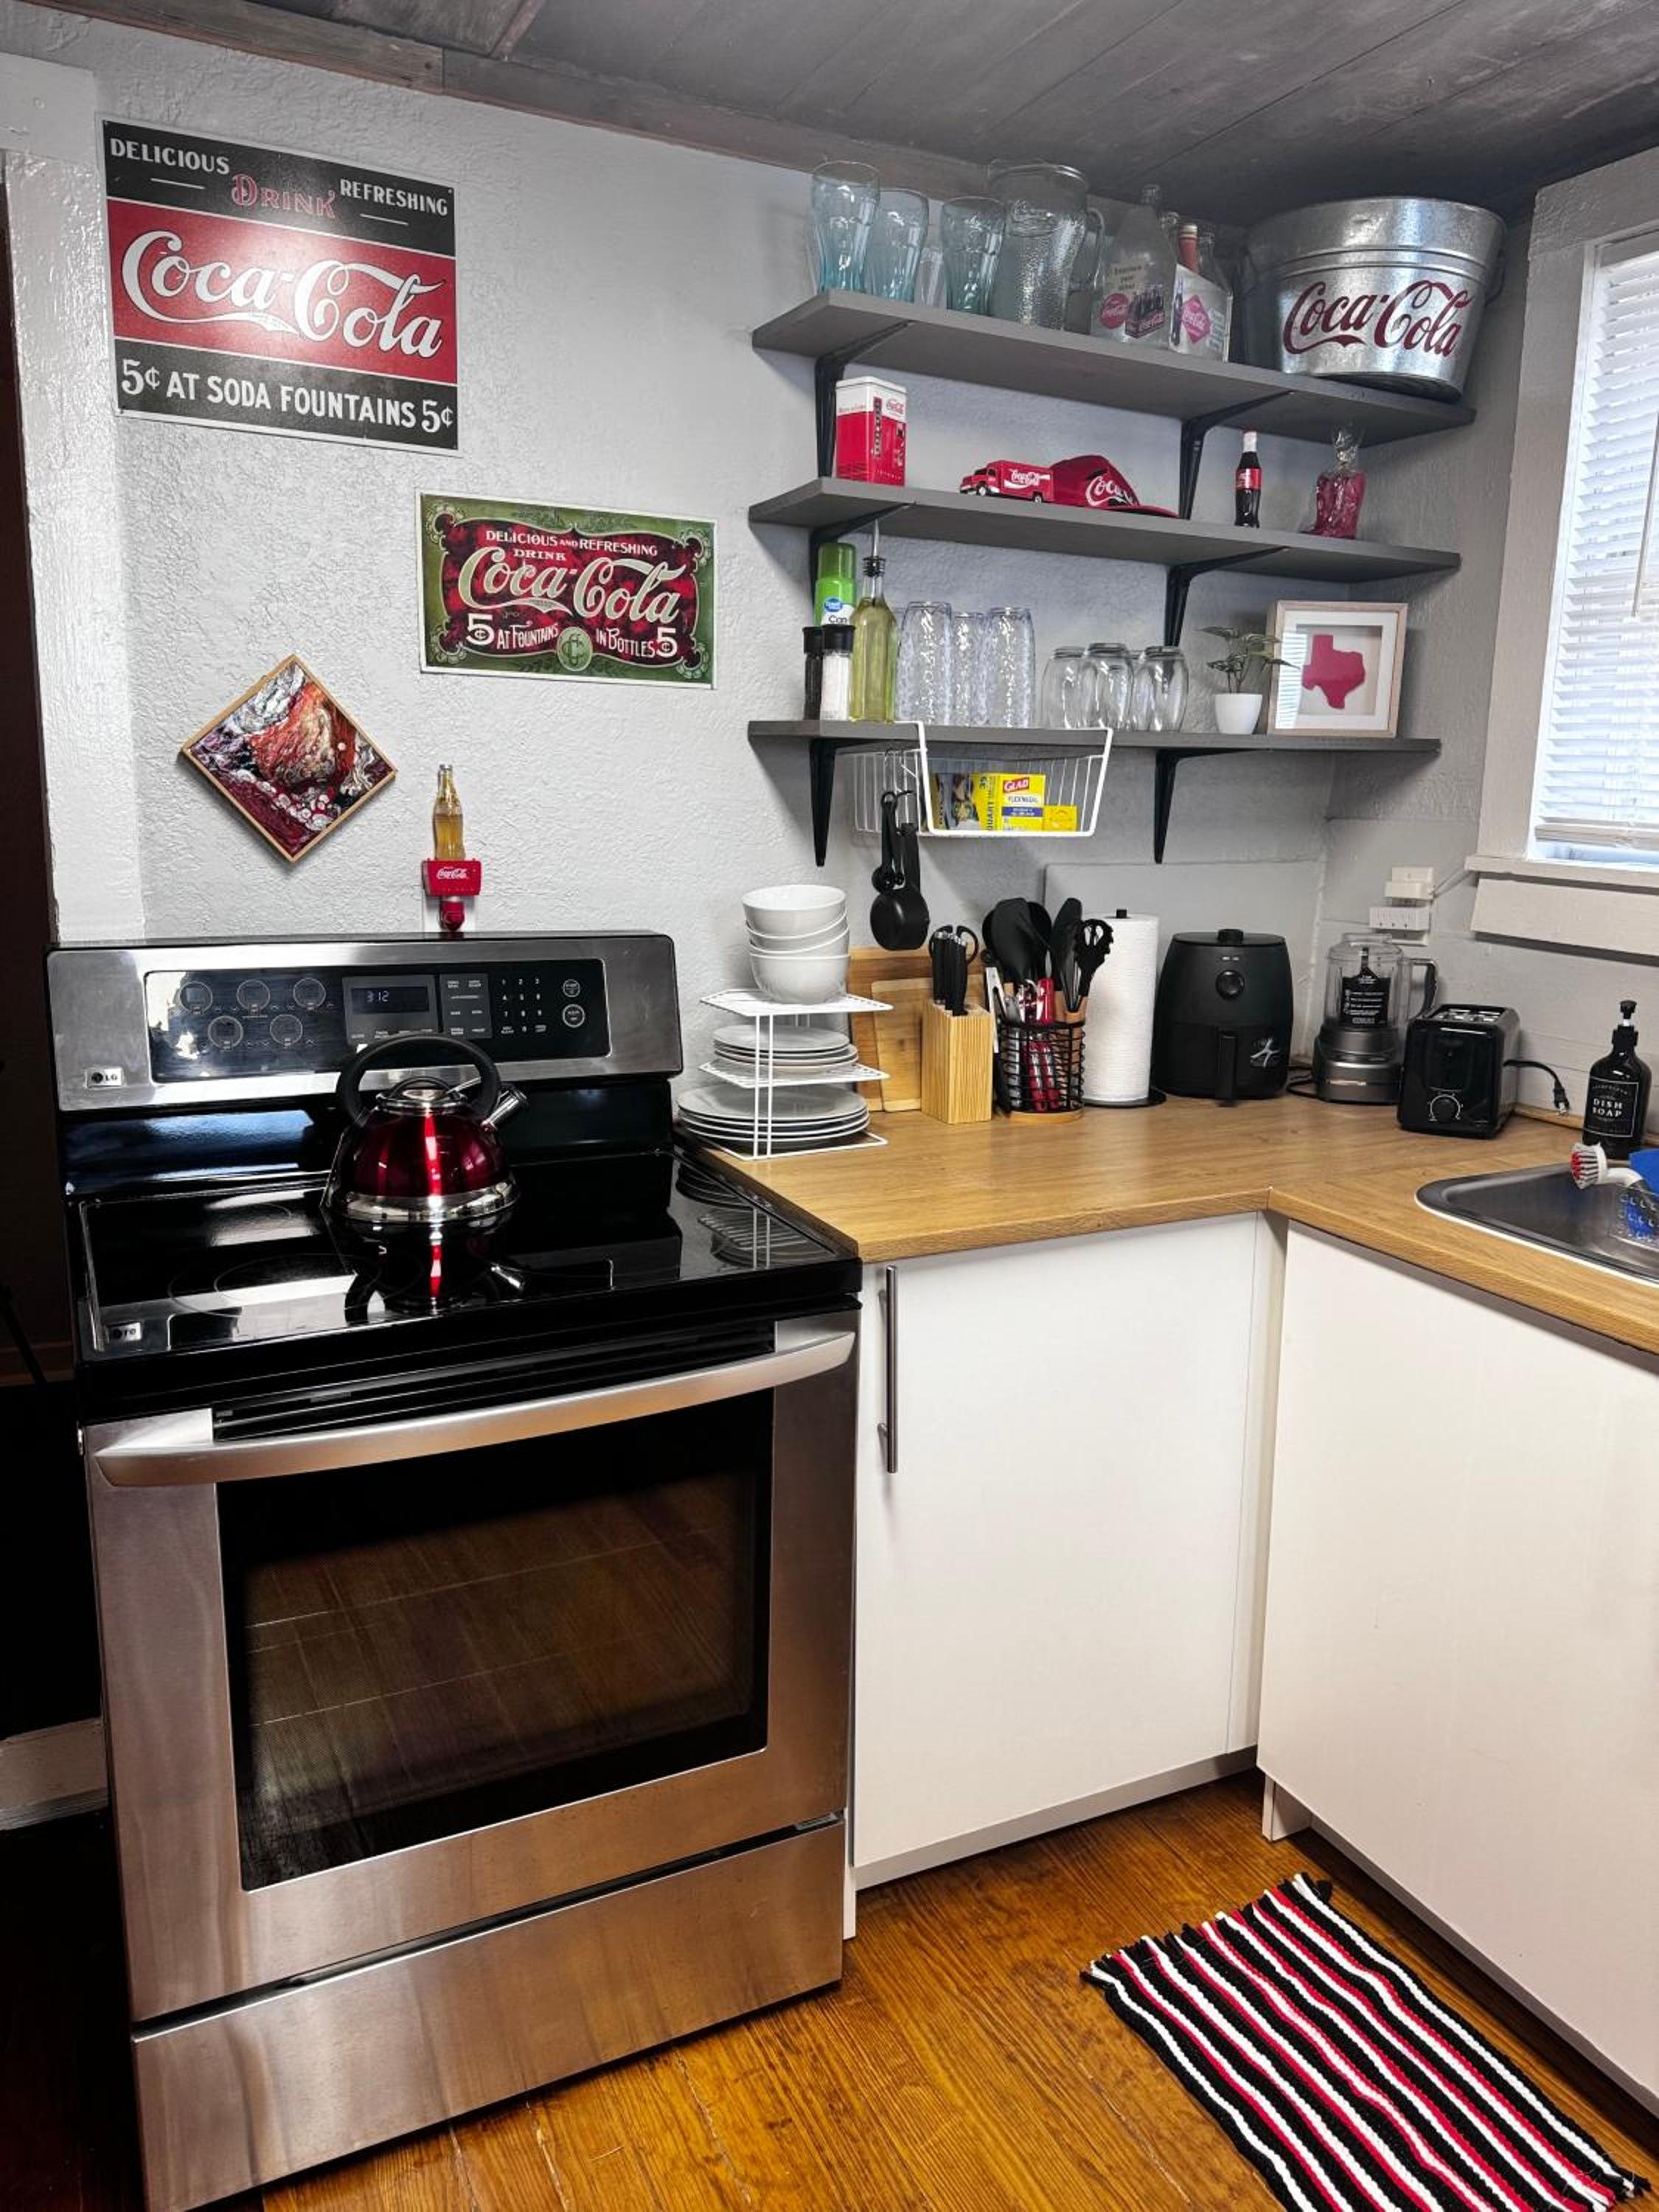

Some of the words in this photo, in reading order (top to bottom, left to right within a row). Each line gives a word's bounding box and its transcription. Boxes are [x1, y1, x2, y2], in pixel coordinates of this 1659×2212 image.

[110, 136, 230, 175] DELICIOUS
[339, 178, 448, 217] REFRESHING
[231, 173, 336, 220] DRINK
[121, 230, 447, 358] Coca-Cola
[1282, 279, 1473, 357] Coca-Cola
[120, 359, 161, 396] 5¢
[166, 371, 201, 400] AT
[206, 375, 271, 411] SODA
[279, 385, 417, 428] FOUNTAINS
[420, 399, 455, 433] 5¢
[485, 529, 558, 547] DELICIOUS
[579, 538, 658, 557] REFRESHING
[513, 548, 567, 561] DRINK
[458, 546, 686, 624] Coca-Cola
[496, 629, 511, 649] AT
[509, 620, 559, 649] FOUNTAINS
[595, 627, 607, 647] IN
[605, 627, 656, 658] BOTTLES
[1004, 779, 1029, 791] GLAD
[1593, 1098, 1623, 1110] DISH
